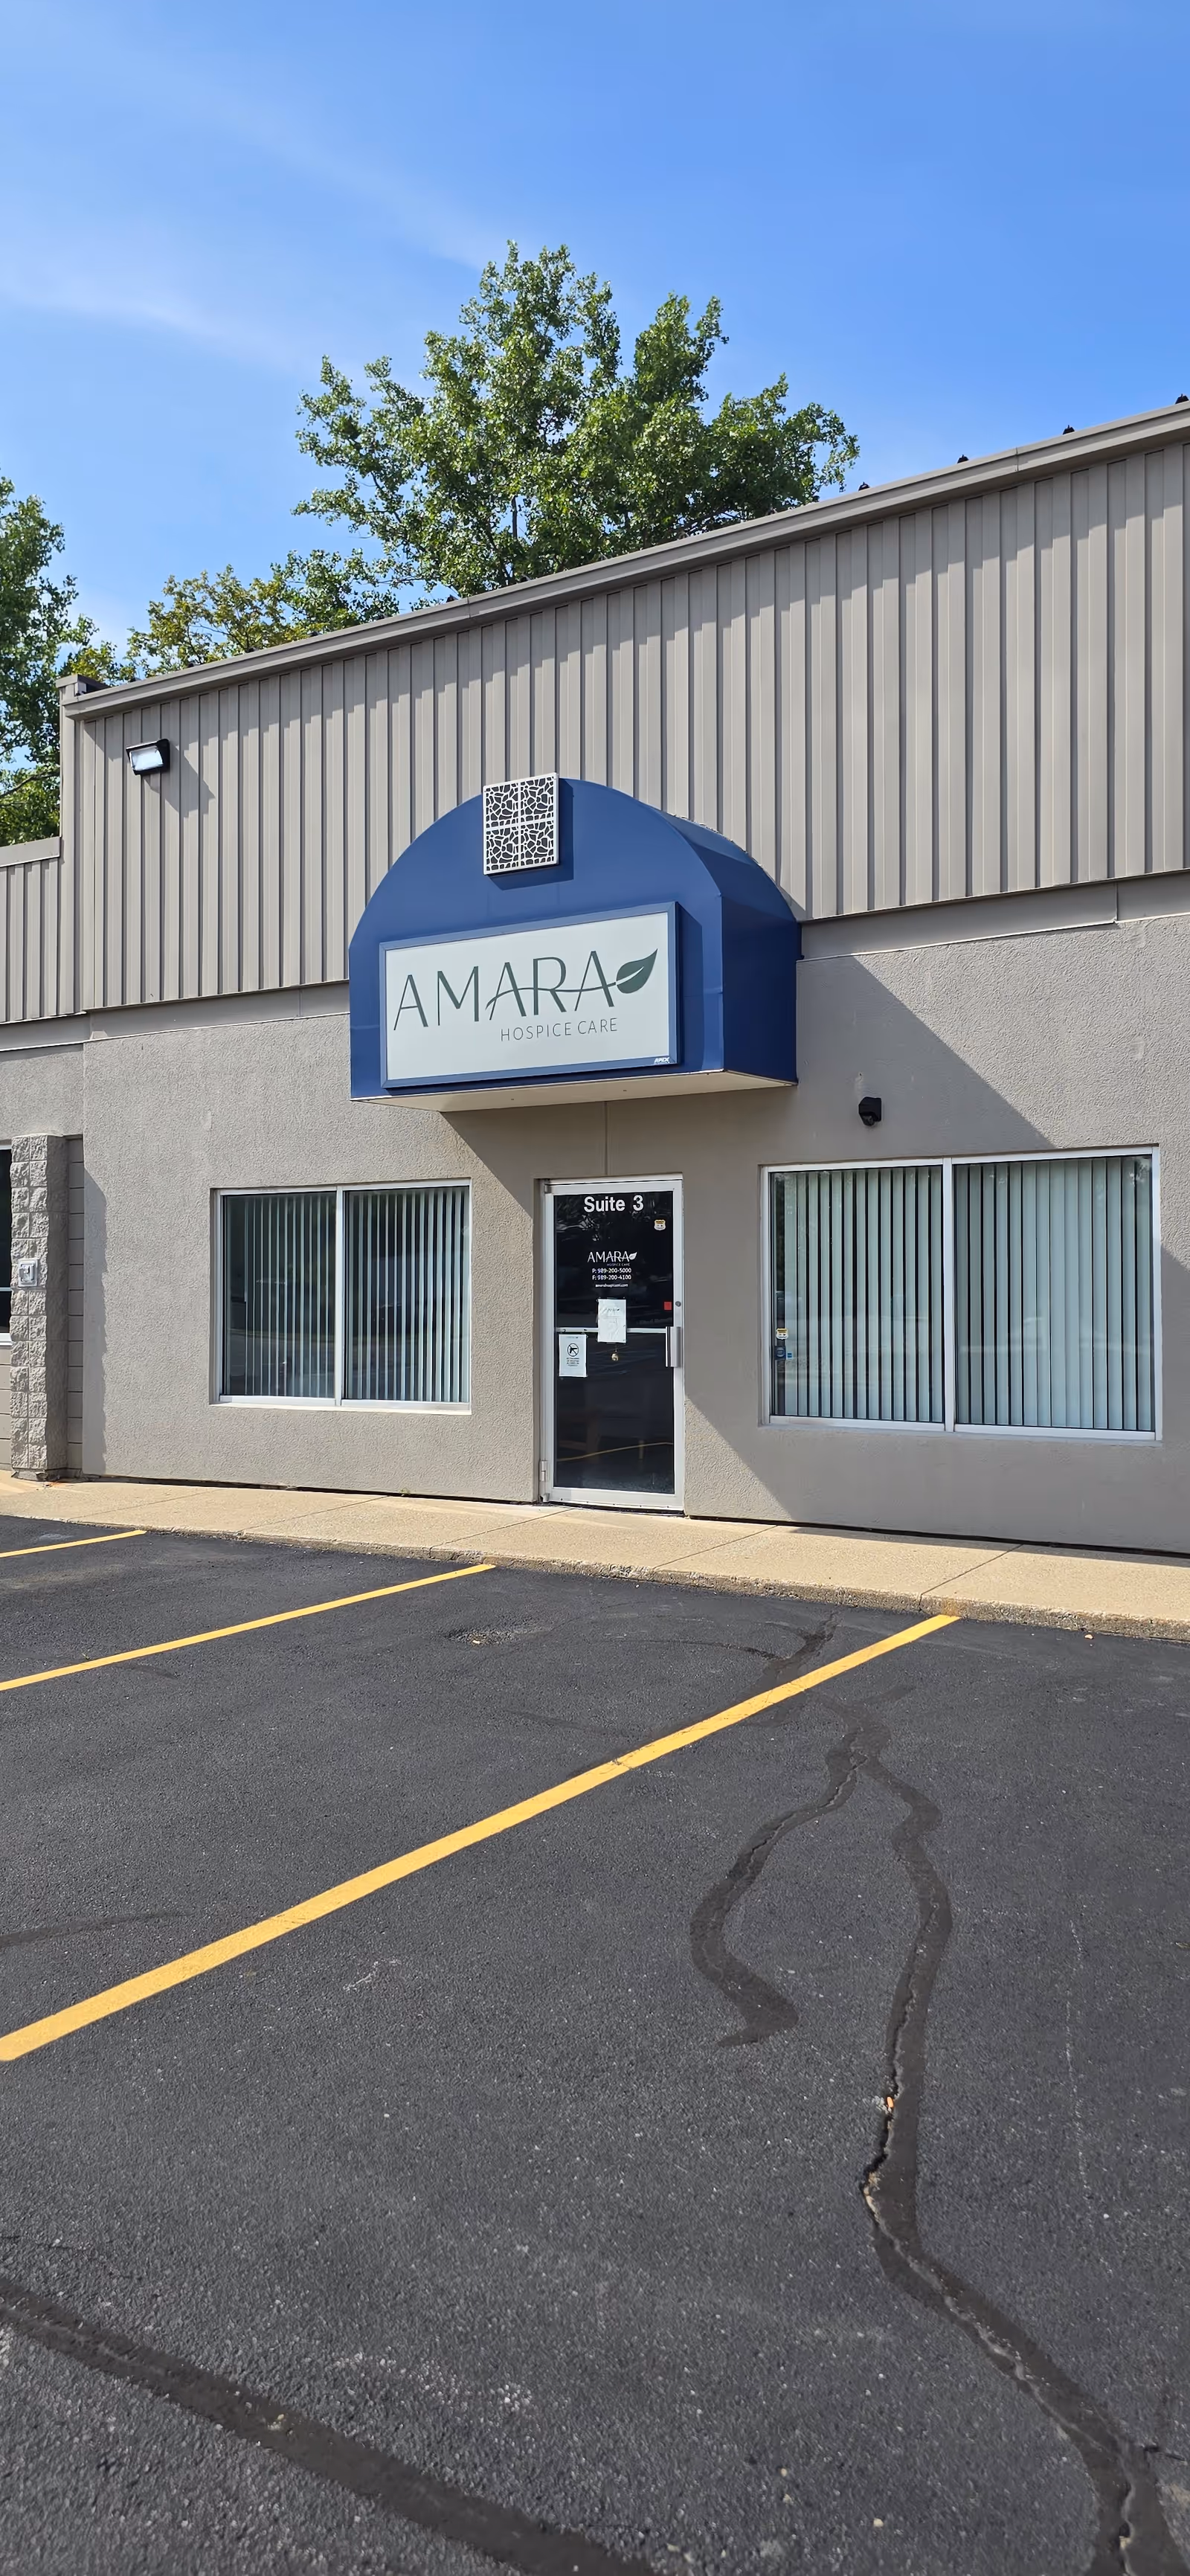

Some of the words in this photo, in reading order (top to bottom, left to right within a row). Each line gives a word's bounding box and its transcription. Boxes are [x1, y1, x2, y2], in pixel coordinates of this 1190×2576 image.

[393, 950, 617, 1031] AMARA
[501, 1022, 572, 1041] HOSPICE
[577, 1017, 618, 1035] CARE
[583, 1195, 625, 1212] Suite
[632, 1195, 644, 1211] 3
[587, 1250, 630, 1263] AMARA
